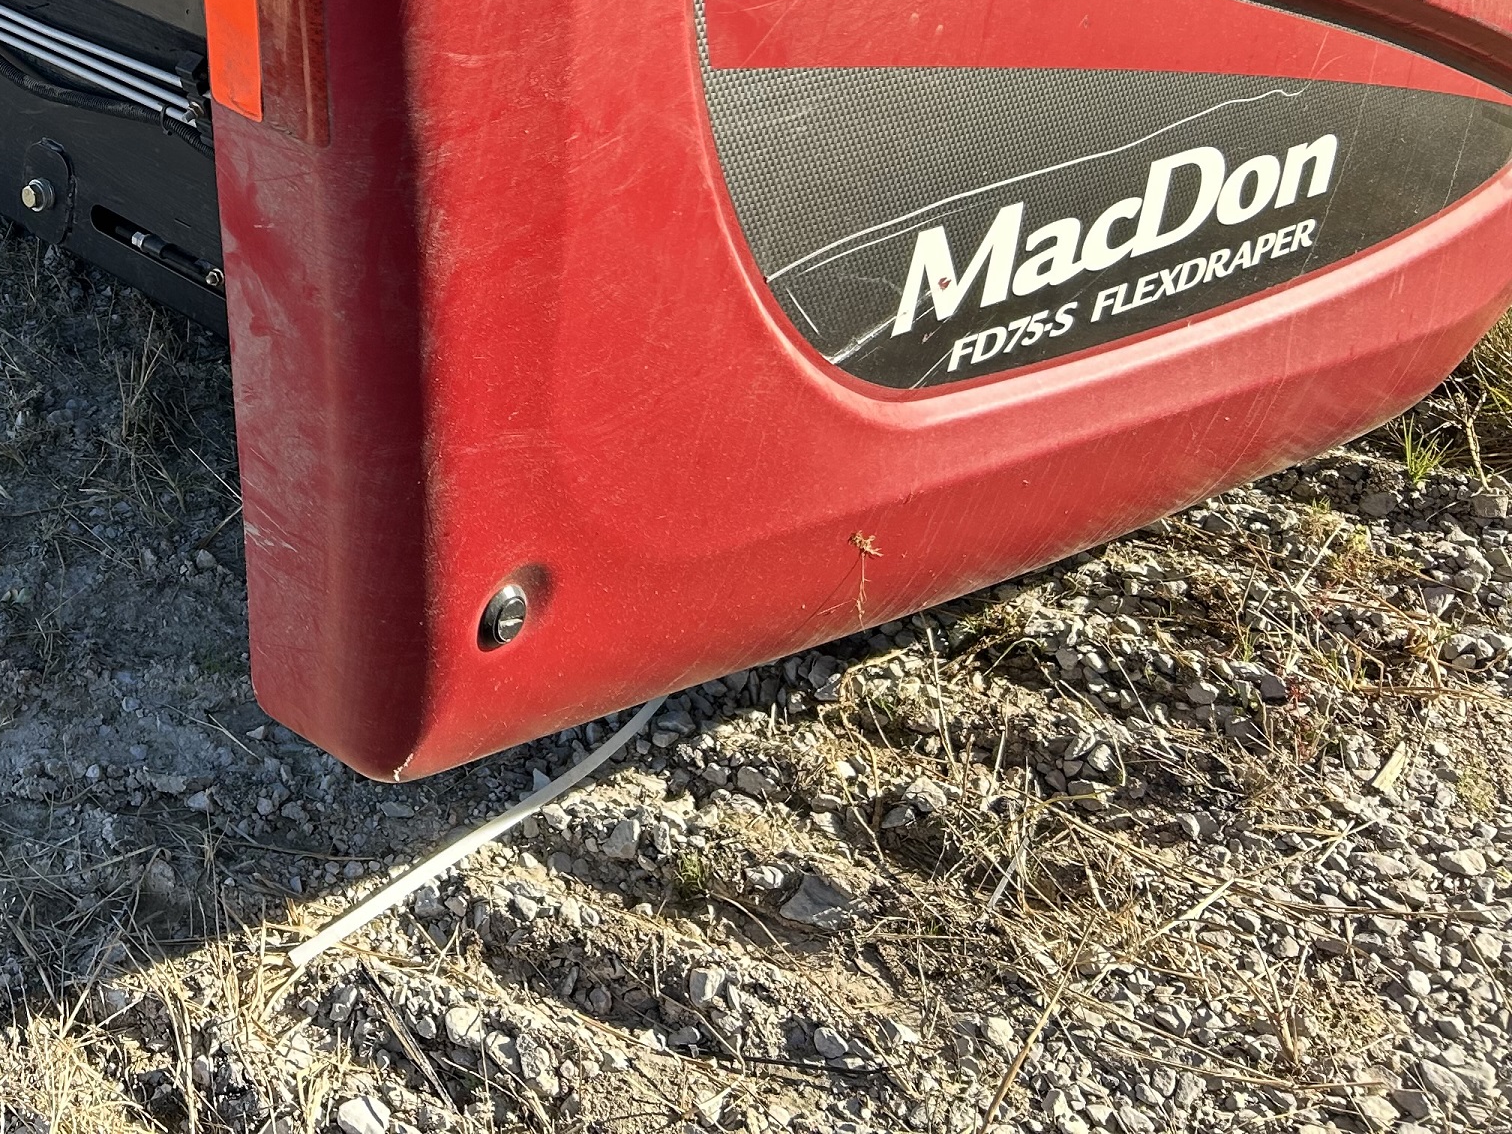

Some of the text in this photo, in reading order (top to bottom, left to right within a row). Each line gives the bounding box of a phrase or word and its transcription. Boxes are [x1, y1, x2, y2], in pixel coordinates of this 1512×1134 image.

[890, 133, 1338, 338] MacDon
[946, 218, 1317, 373] FD75-S FLEXDRAPER
